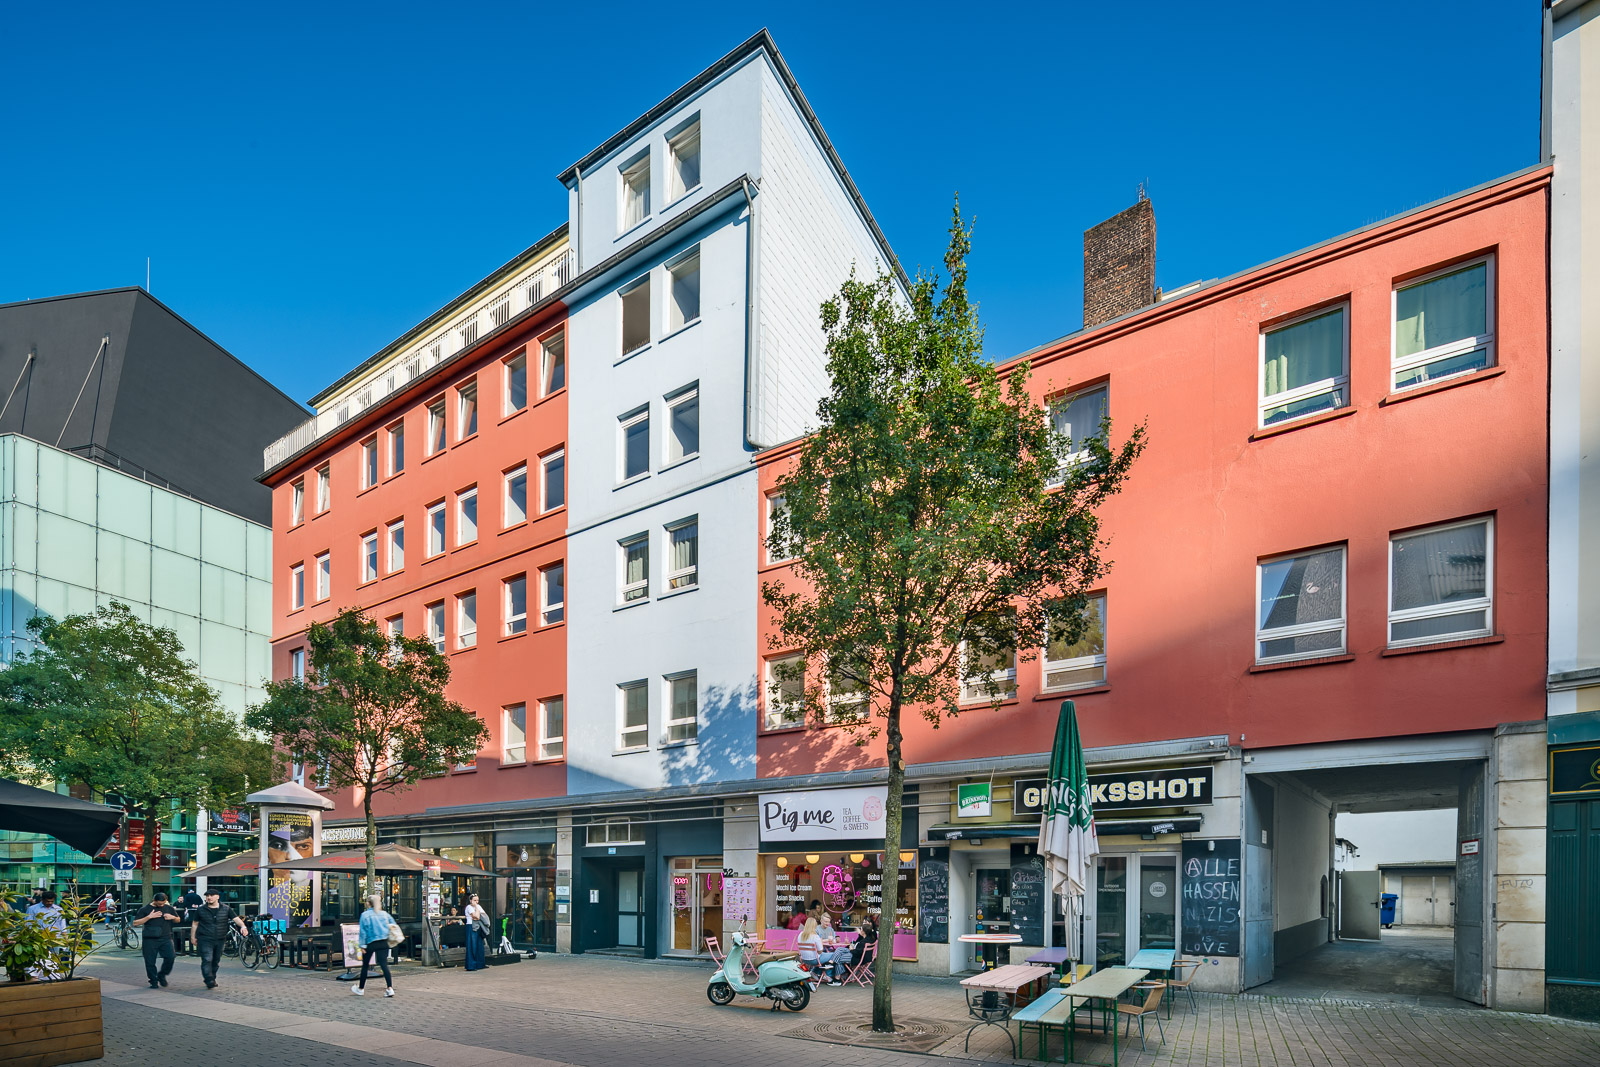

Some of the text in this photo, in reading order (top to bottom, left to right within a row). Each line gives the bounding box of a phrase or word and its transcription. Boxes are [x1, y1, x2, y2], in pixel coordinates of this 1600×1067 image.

[1023, 777, 1207, 808] GKSSHOT
[843, 808, 852, 816] TEA
[843, 816, 861, 824] COFFEE
[1185, 858, 1239, 877] ALLE
[674, 877, 689, 885] open
[276, 885, 311, 894] THESE
[1183, 881, 1240, 902] HASSEN
[269, 893, 311, 902] PEOPLE
[867, 895, 882, 903] Coffe
[269, 899, 299, 909] WHO
[293, 908, 310, 917] AM
[1185, 942, 1229, 953] LOVE
